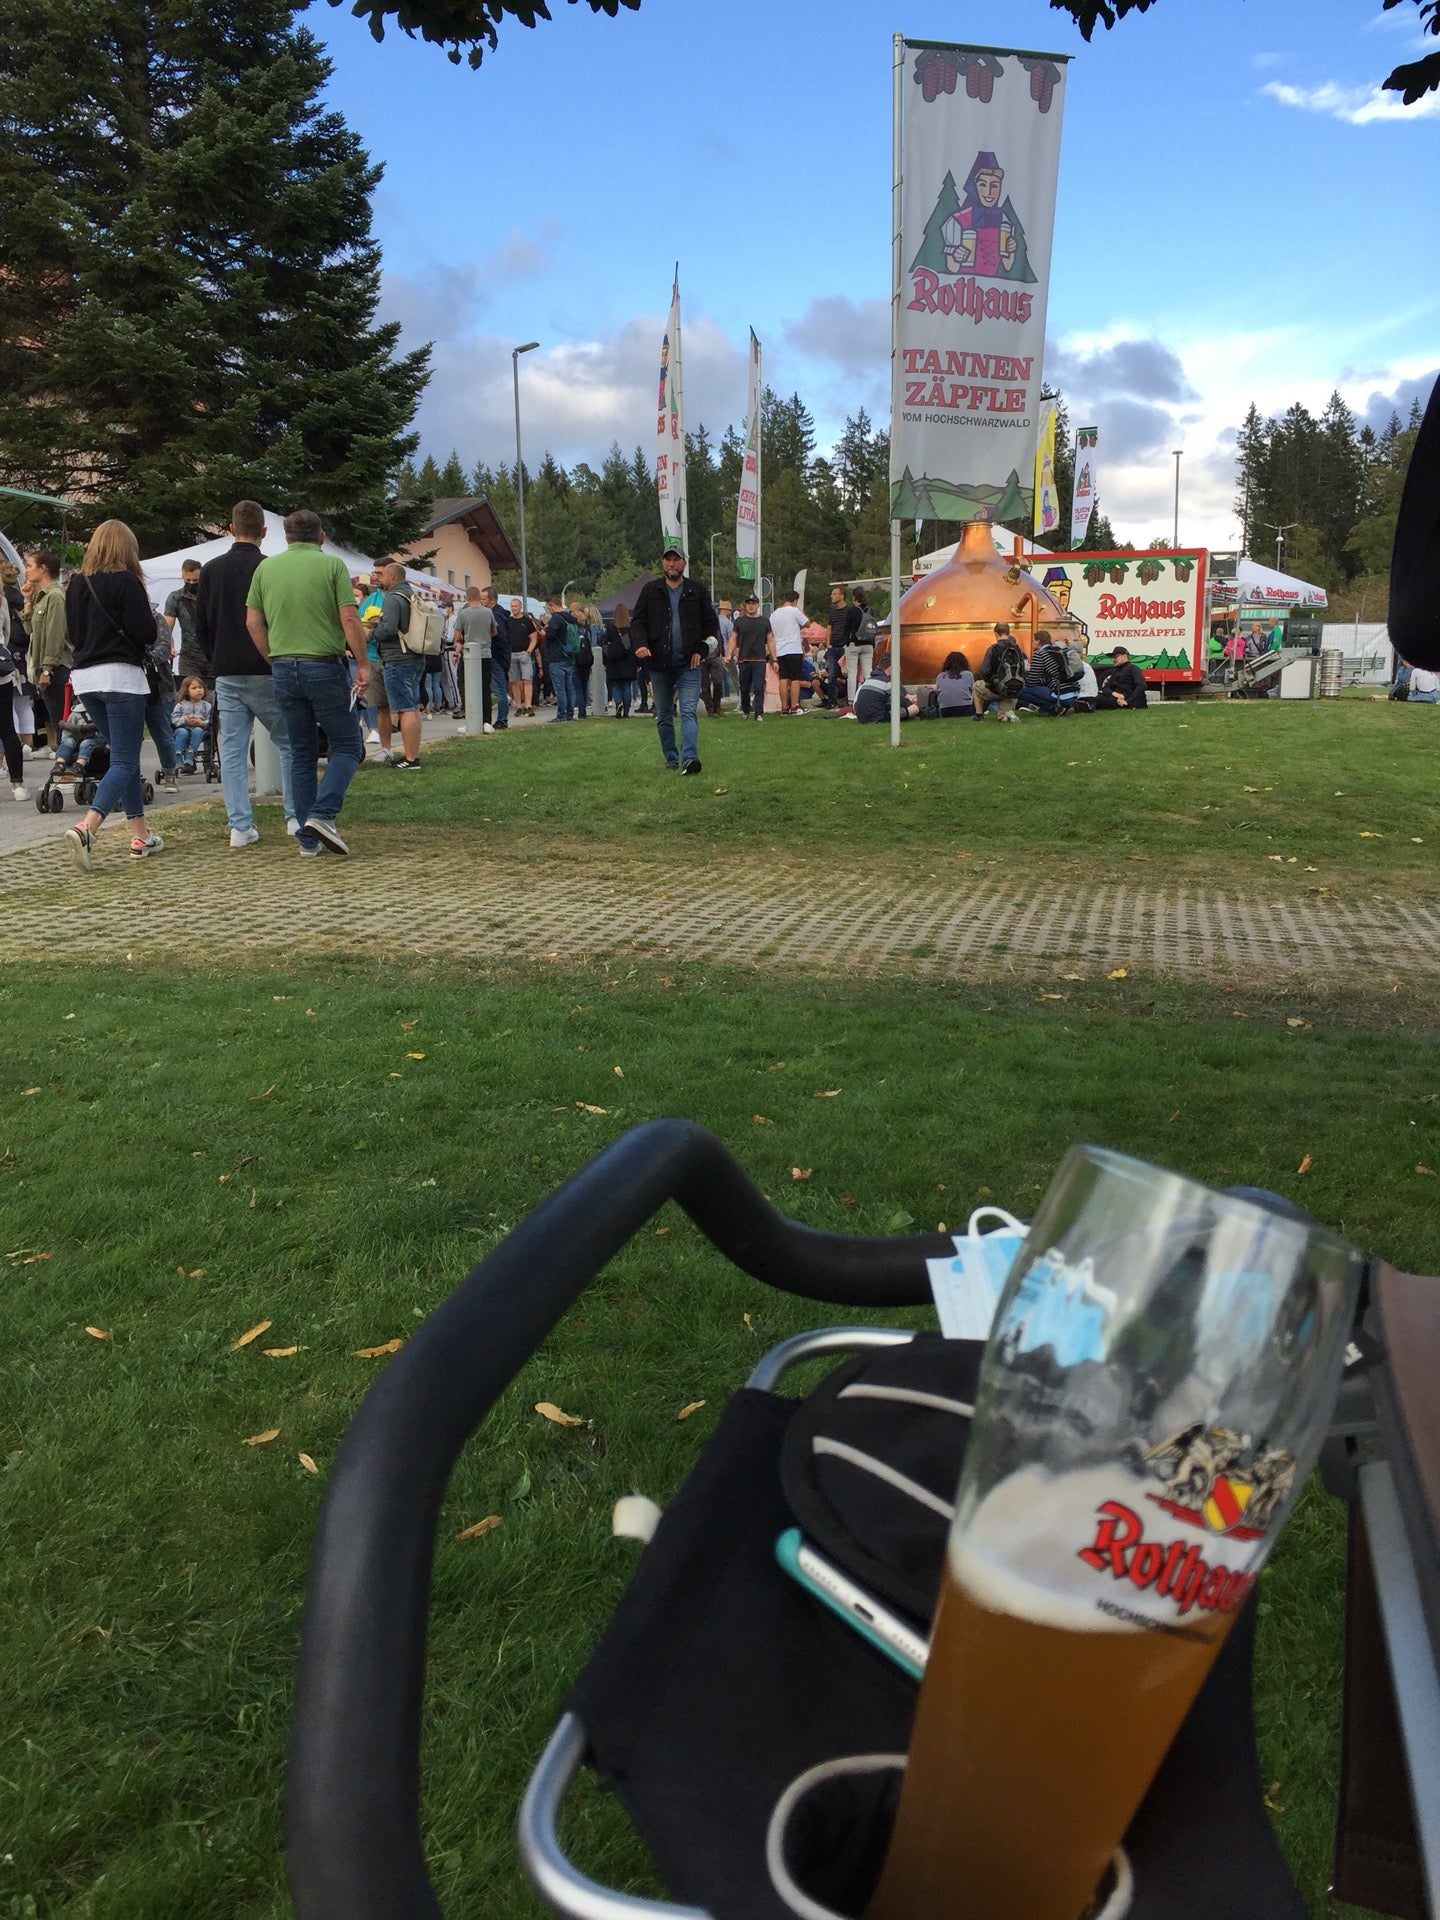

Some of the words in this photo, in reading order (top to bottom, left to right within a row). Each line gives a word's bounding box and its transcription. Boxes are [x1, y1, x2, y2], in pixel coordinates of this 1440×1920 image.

[906, 267, 1034, 325] Rothaus
[902, 349, 1034, 382] TANNEN
[904, 375, 1026, 412] ZÄPFLE
[902, 412, 922, 423] VOM
[925, 413, 1031, 428] HOCHSCHWARZWALD
[1096, 593, 1186, 624] Rothaus
[1265, 586, 1299, 600] Rothaus
[1094, 627, 1186, 638] TANNENZÄPFLE
